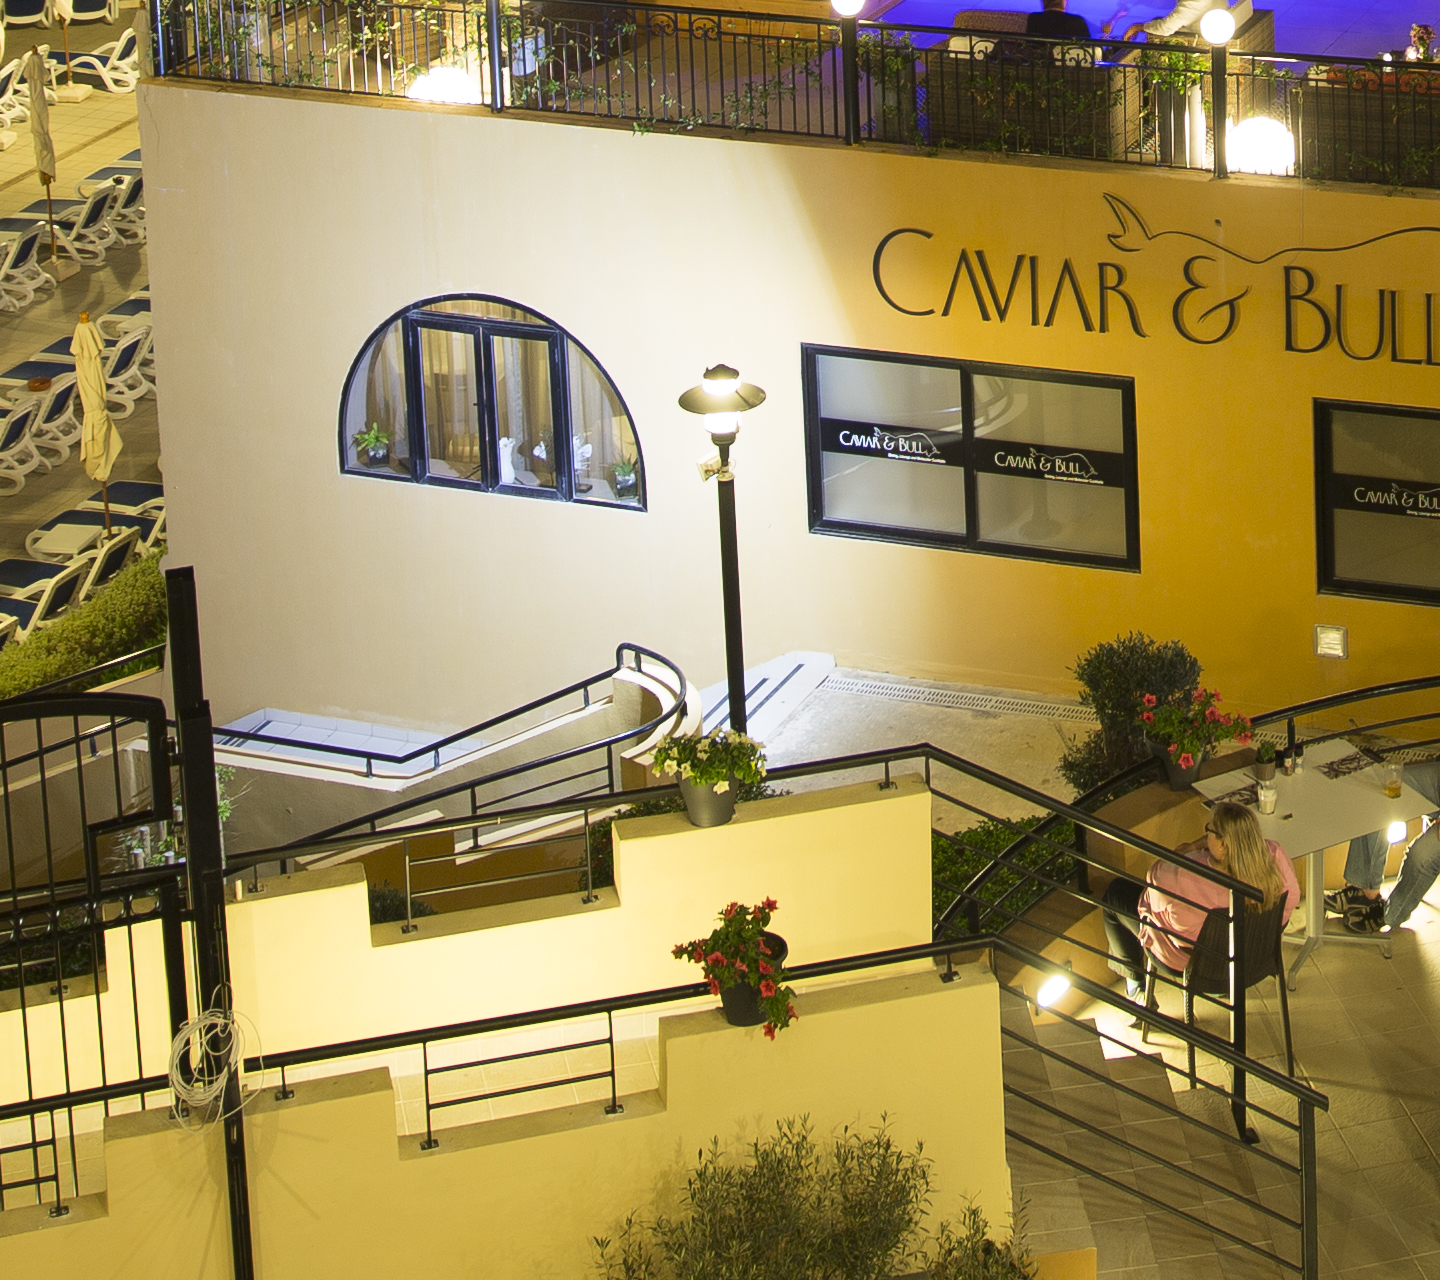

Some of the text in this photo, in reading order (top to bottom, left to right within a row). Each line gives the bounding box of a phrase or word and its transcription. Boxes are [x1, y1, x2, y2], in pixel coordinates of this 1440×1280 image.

[872, 227, 1150, 339] CAVIAR
[1171, 255, 1252, 345] &
[839, 430, 926, 454] CAVIAR & BULL
[994, 451, 1083, 475] CAVIAR & BULL
[1353, 487, 1399, 506] CAVIAR
[1401, 491, 1415, 507] &
